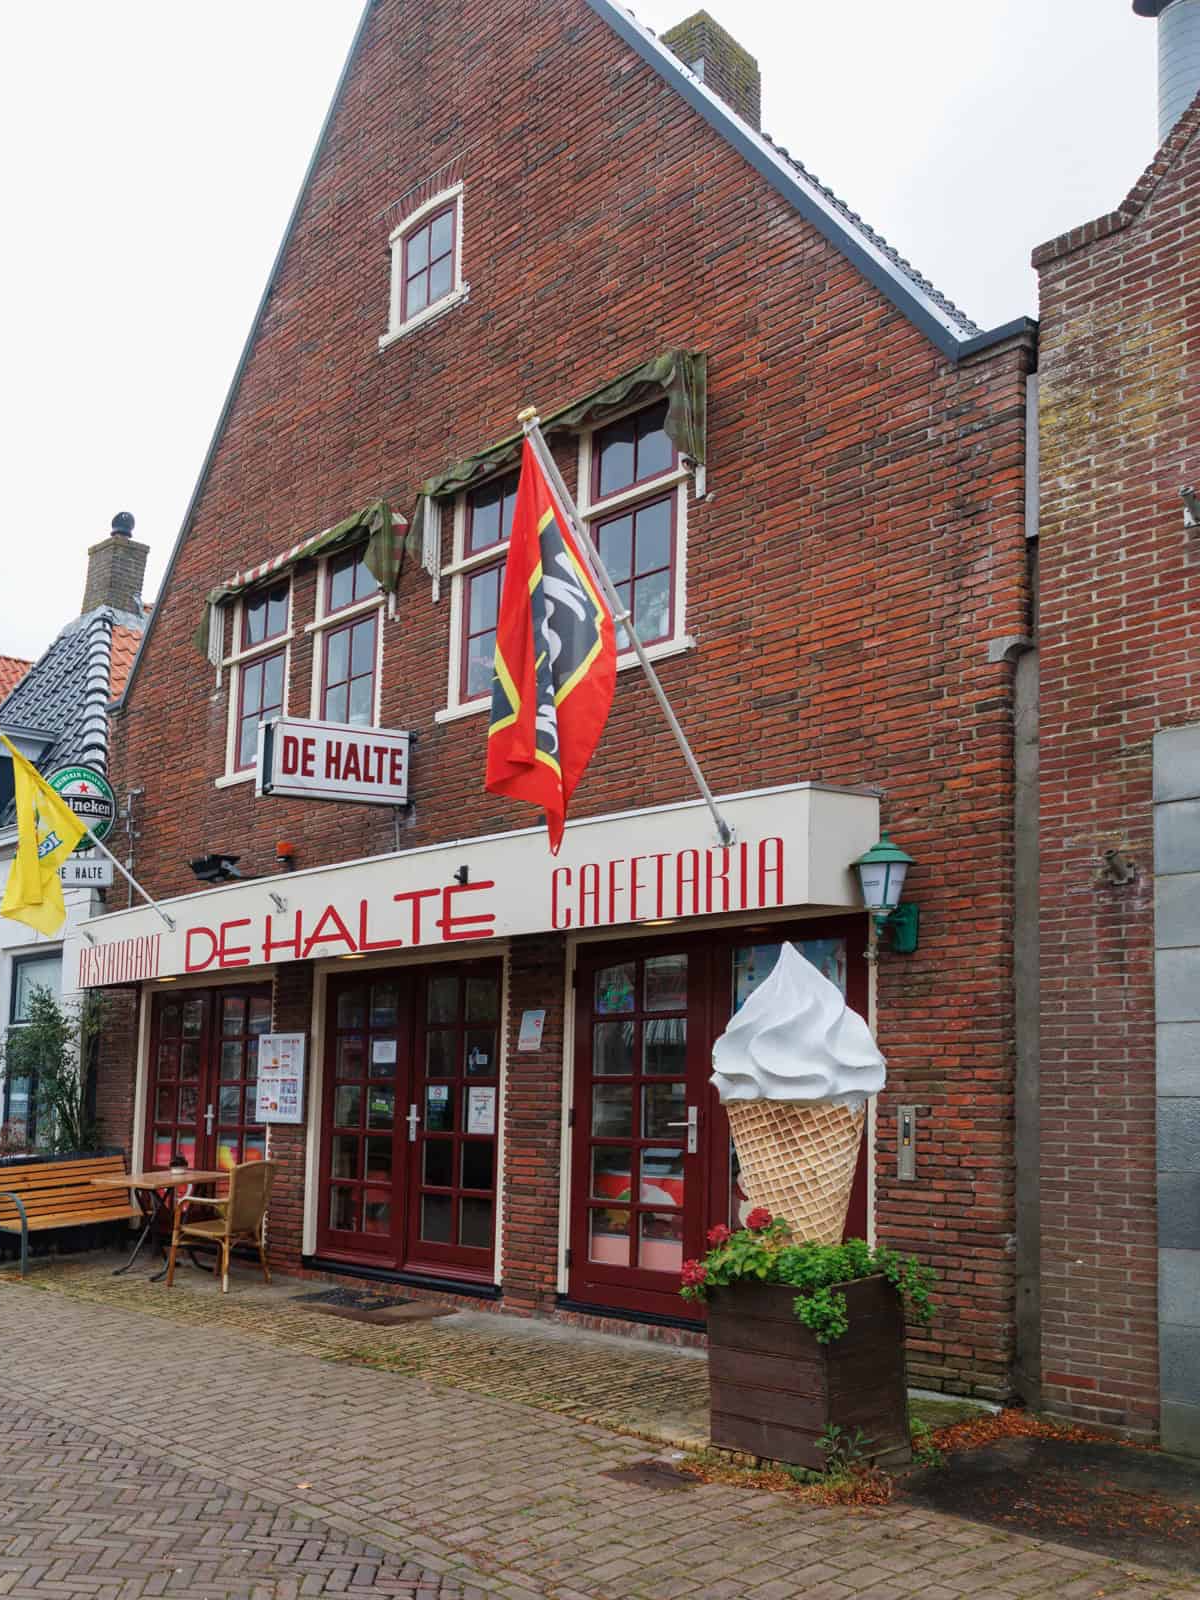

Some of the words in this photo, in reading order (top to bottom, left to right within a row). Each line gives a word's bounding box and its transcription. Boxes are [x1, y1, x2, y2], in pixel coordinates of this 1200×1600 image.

[282, 735, 317, 778] DE
[324, 740, 404, 786] HALTE
[64, 798, 111, 816] ineken
[75, 866, 103, 880] HALTE
[78, 933, 161, 988] RESTAURANT
[184, 917, 252, 973] DE
[262, 880, 496, 963] HALTE
[551, 836, 784, 930] CAFETARIA
